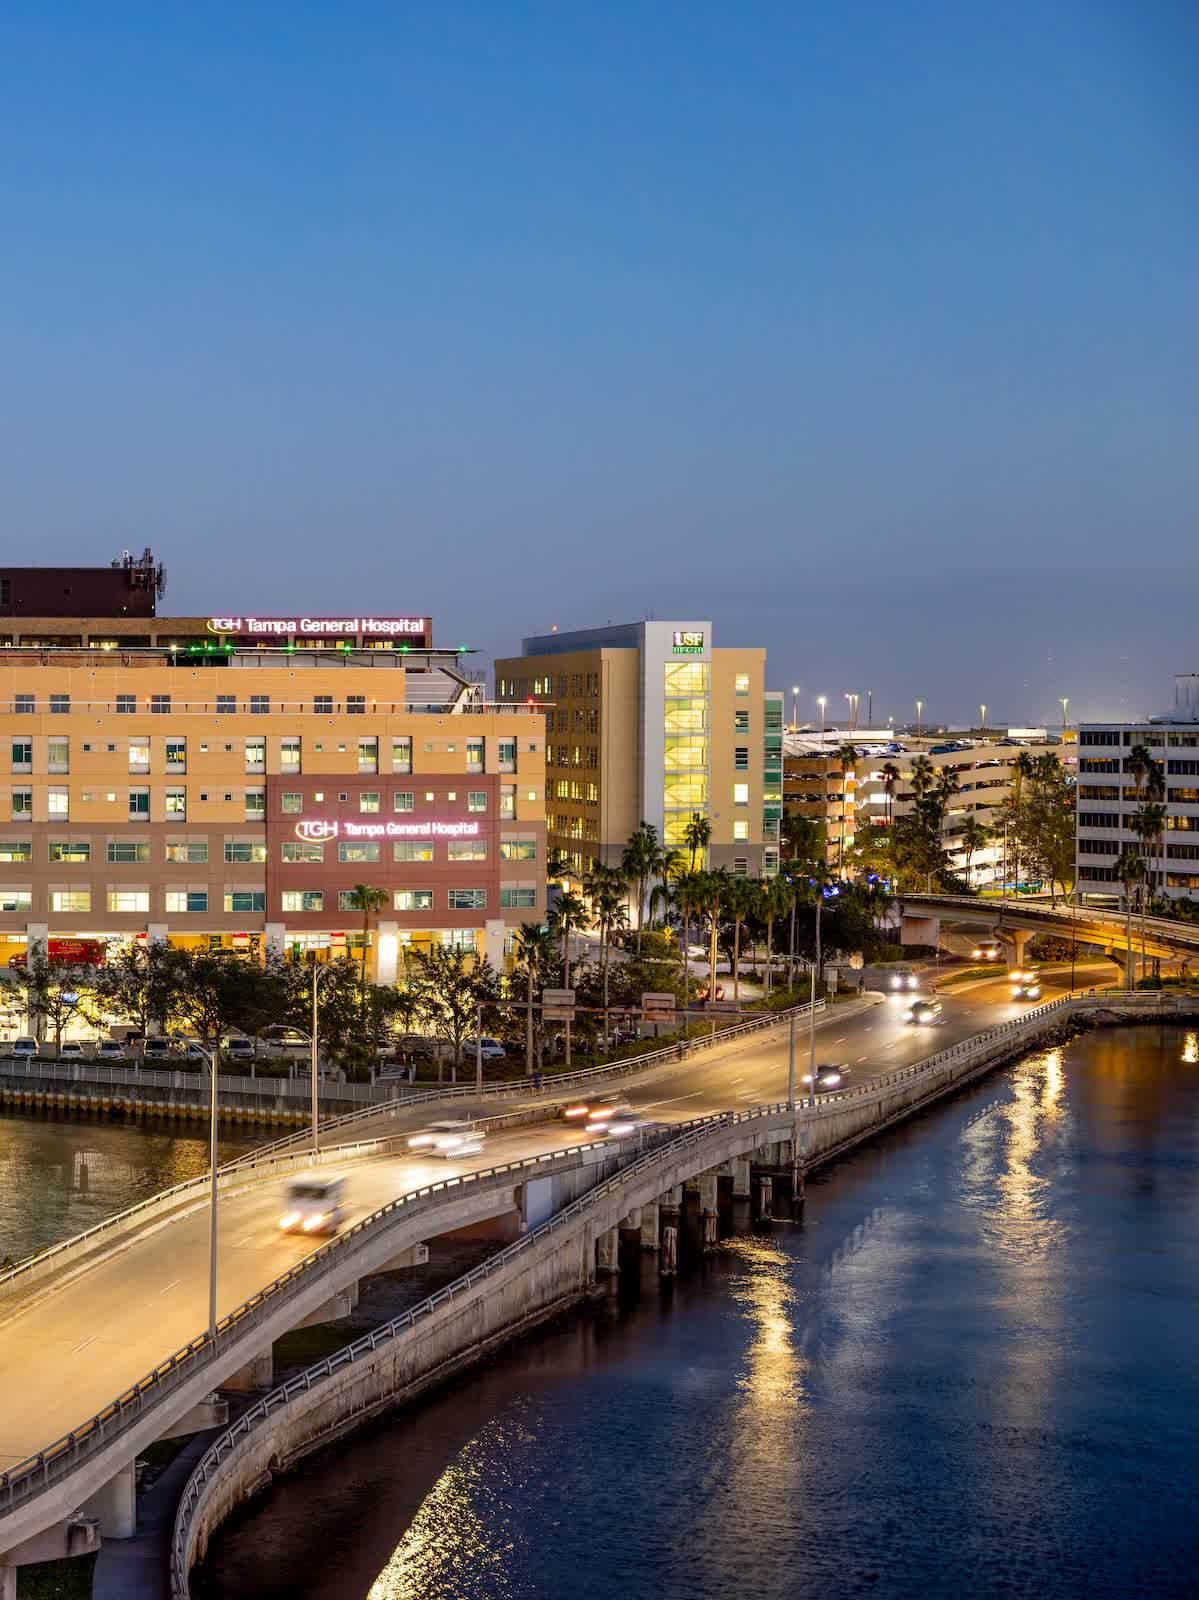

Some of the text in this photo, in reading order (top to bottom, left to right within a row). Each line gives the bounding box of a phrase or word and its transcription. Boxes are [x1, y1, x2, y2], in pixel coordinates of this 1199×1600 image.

[211, 618, 424, 635] TGH Tampa General Hospital
[674, 632, 703, 646] USF
[301, 821, 478, 837] TGH Tampa General Hospital
